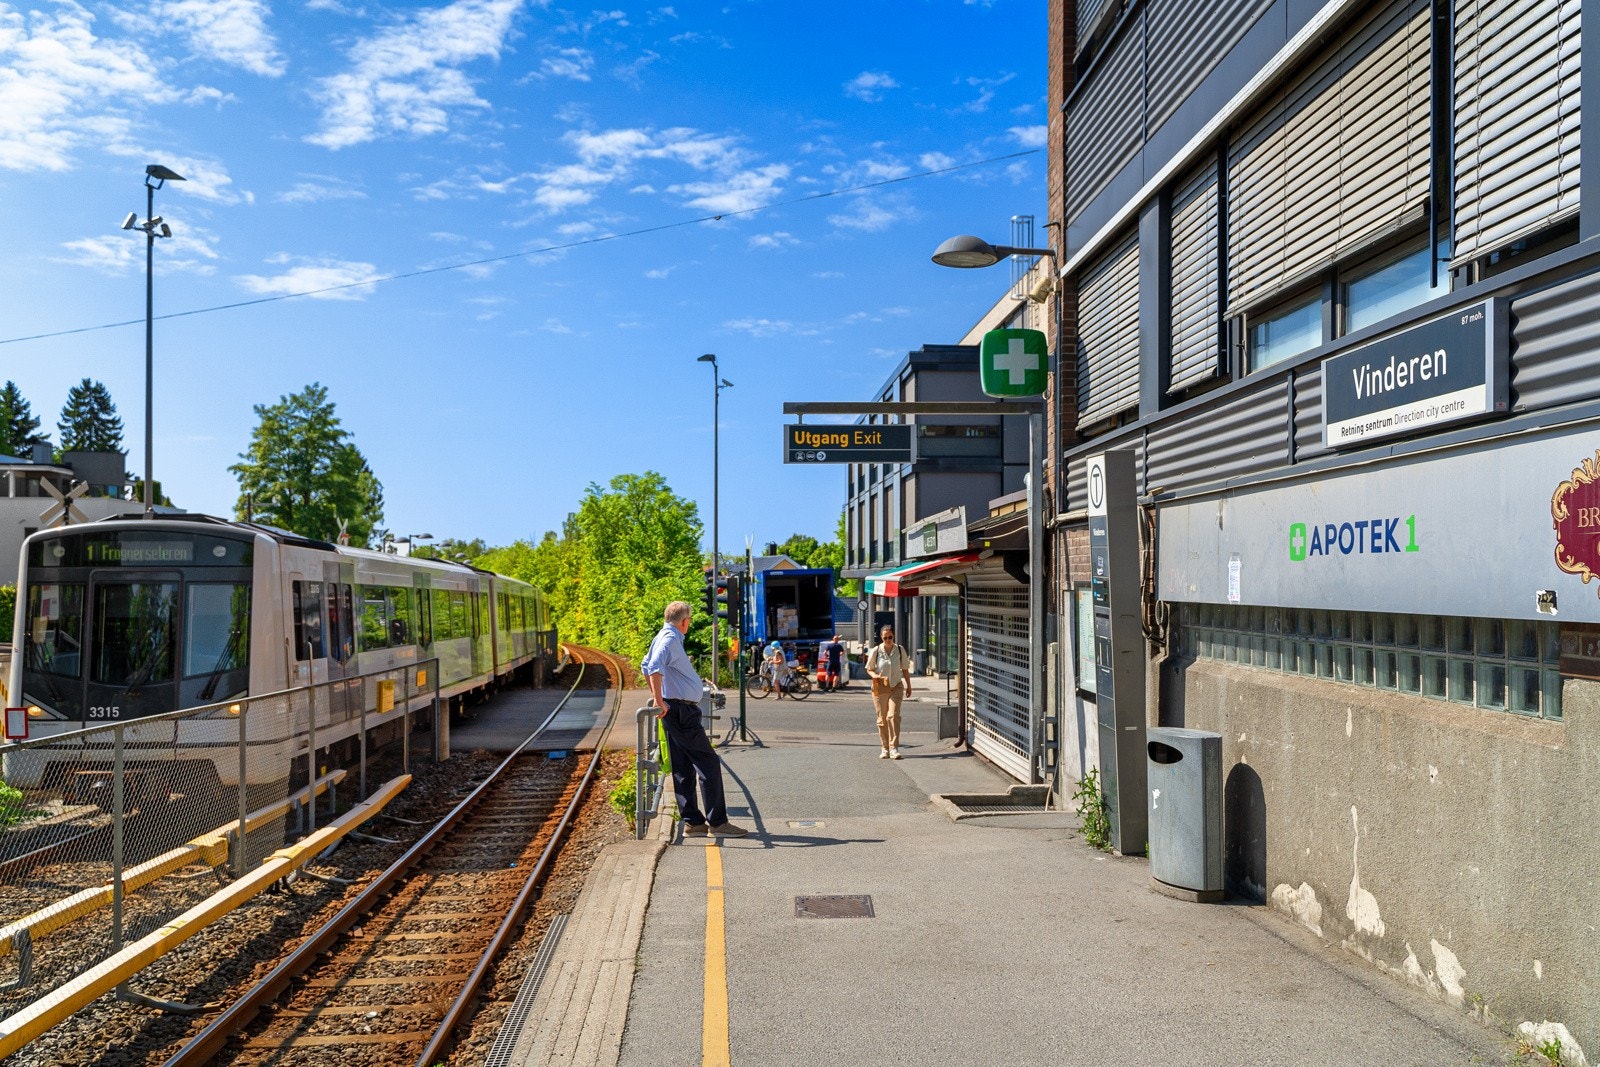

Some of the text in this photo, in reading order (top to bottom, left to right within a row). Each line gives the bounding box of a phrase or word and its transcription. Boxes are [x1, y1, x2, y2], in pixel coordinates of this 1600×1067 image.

[1461, 311, 1484, 325] 87 moh.
[1353, 348, 1447, 400] Vinderen
[1341, 400, 1465, 437] Retning sentrum Direction city centre
[794, 430, 882, 448] Utgang Exit
[1309, 517, 1401, 556] APOTEK
[87, 544, 94, 560] 1
[90, 706, 120, 718] 3315
